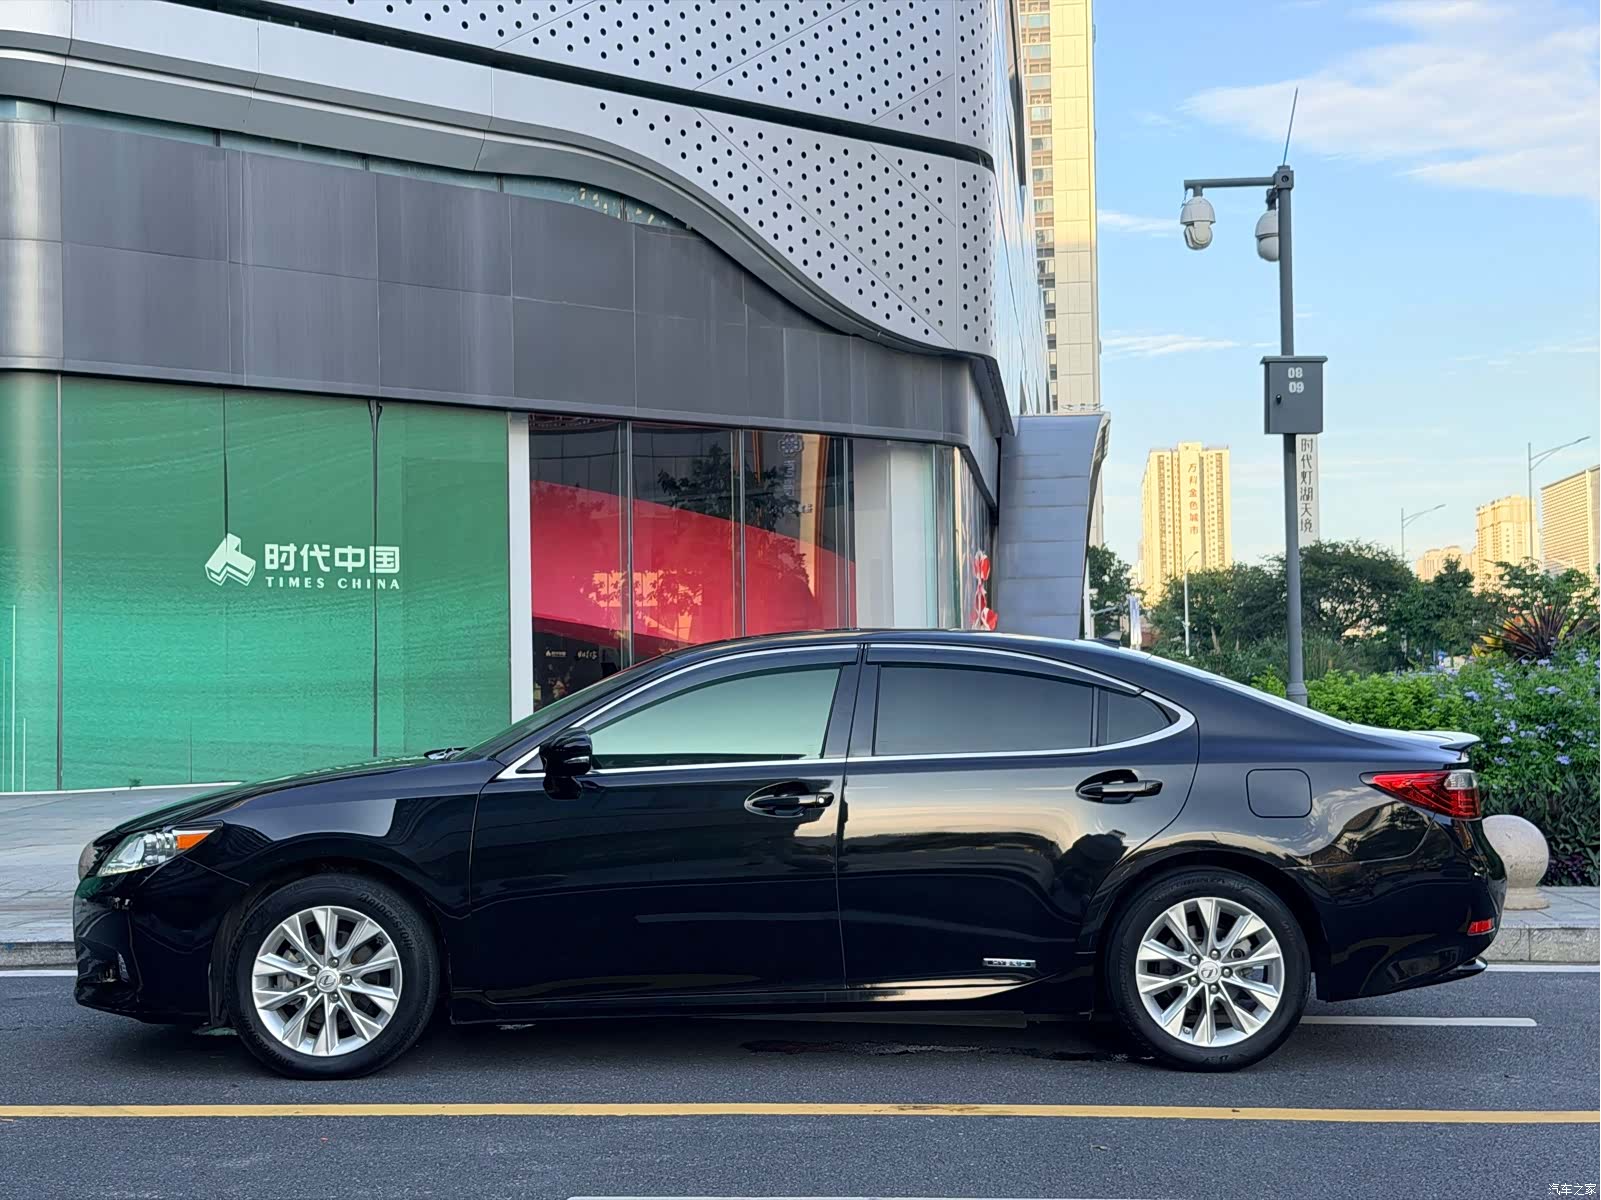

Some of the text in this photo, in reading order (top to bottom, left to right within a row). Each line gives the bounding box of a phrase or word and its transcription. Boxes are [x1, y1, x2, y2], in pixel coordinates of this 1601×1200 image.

[1287, 367, 1303, 378] 08
[1288, 381, 1304, 393] 09
[1300, 438, 1313, 533] 时代灯湖天境
[264, 543, 401, 574] 时代中国
[265, 576, 401, 589] TIMES CHINA
